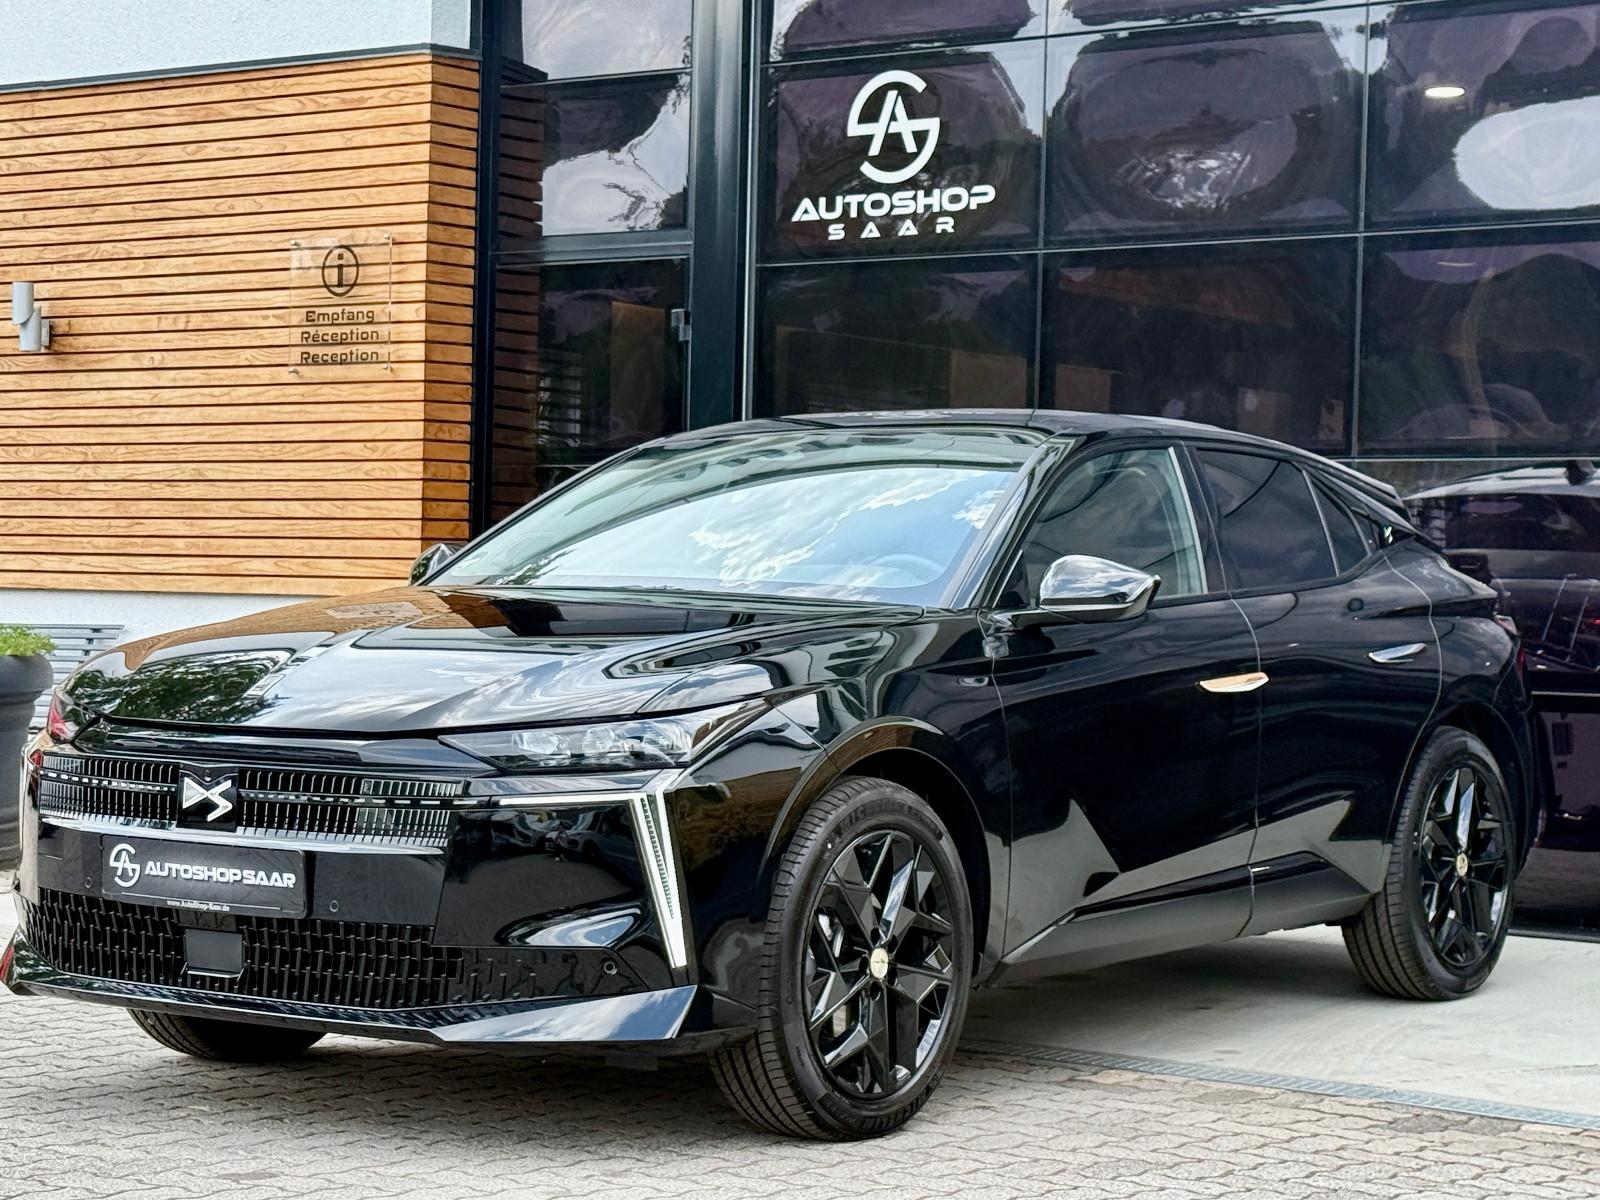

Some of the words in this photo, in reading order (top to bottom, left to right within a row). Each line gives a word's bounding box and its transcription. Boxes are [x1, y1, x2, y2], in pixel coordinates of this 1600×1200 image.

[791, 184, 996, 222] AUTOSHOP
[827, 216, 955, 241] SAAR
[305, 308, 375, 324] Empfang
[301, 328, 379, 344] Réception
[300, 349, 379, 365] Reception
